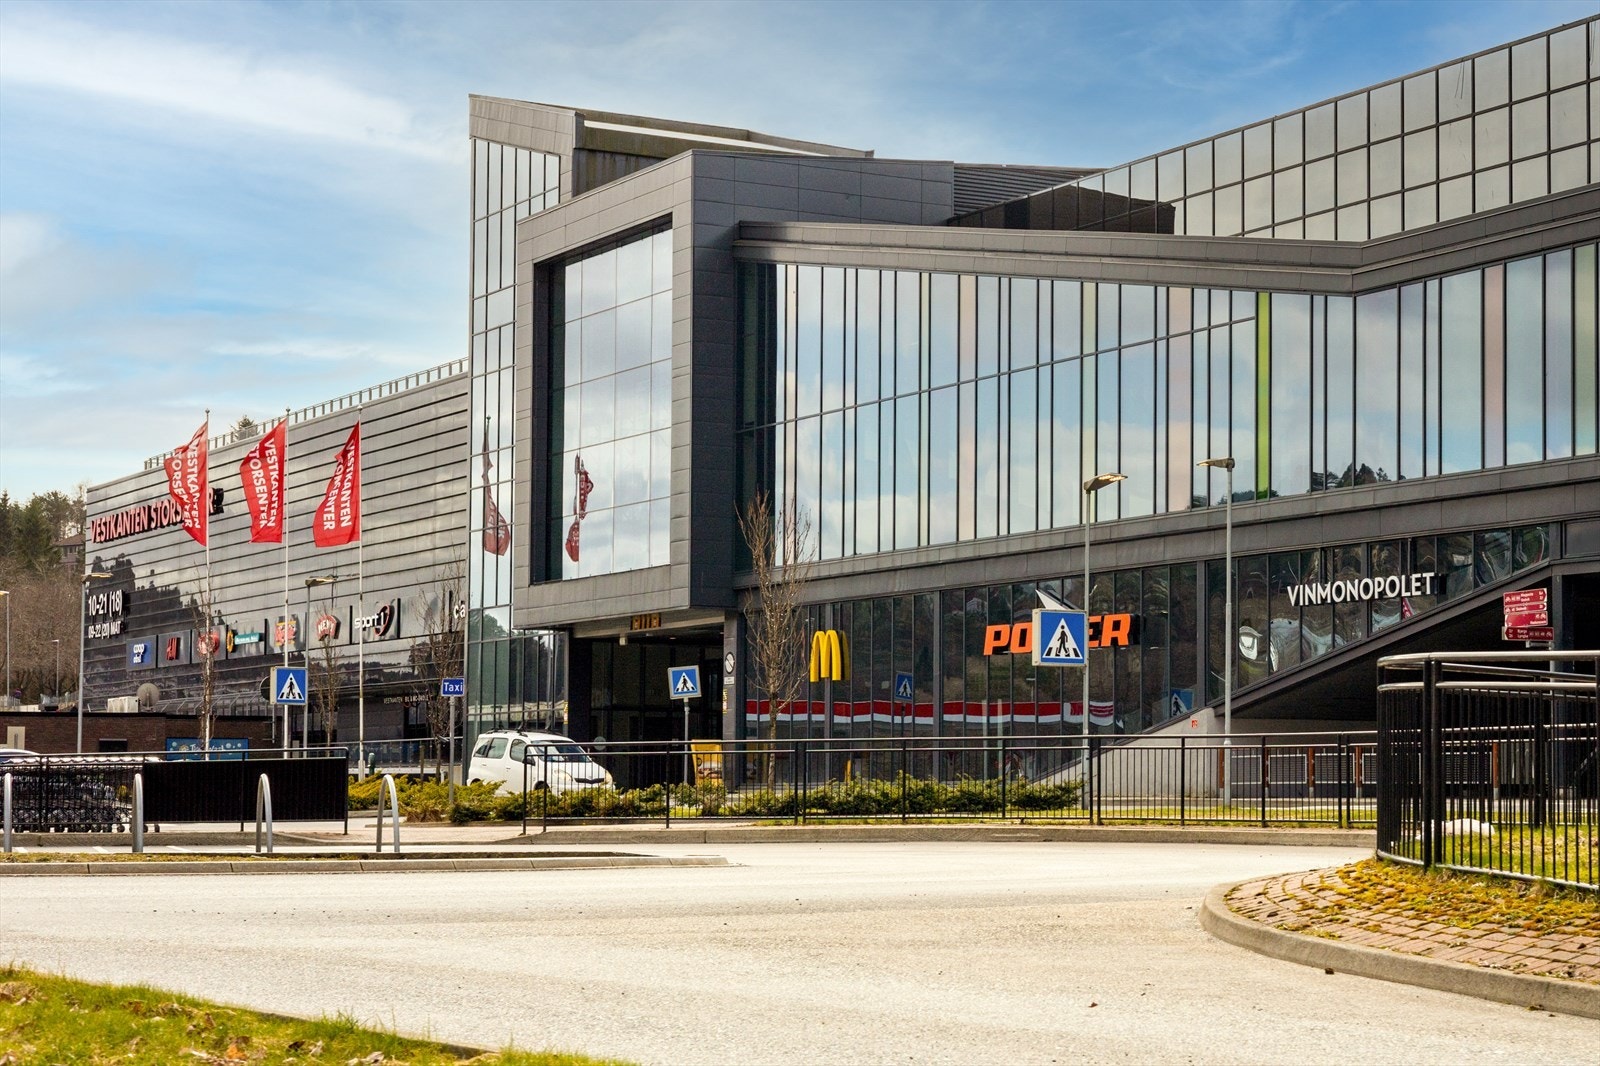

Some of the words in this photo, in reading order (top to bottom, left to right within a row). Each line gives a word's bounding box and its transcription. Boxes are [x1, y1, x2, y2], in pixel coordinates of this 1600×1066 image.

[172, 452, 193, 527] TORSENTER
[187, 443, 201, 529] VESTKANTEN
[264, 438, 280, 527] VESTKANTEN
[323, 457, 344, 530] TORSENTER
[340, 440, 355, 527] VESTKANTEN
[91, 504, 149, 543] VESTKANTEN
[151, 488, 214, 529] STORSR
[88, 593, 107, 616] 10-21
[109, 589, 123, 617] (18)
[1287, 572, 1434, 607] VINMONOPOLET
[88, 623, 101, 639] 09-22
[110, 620, 122, 635] MAT
[983, 613, 1131, 656] POER
[443, 682, 463, 692] Taxi
